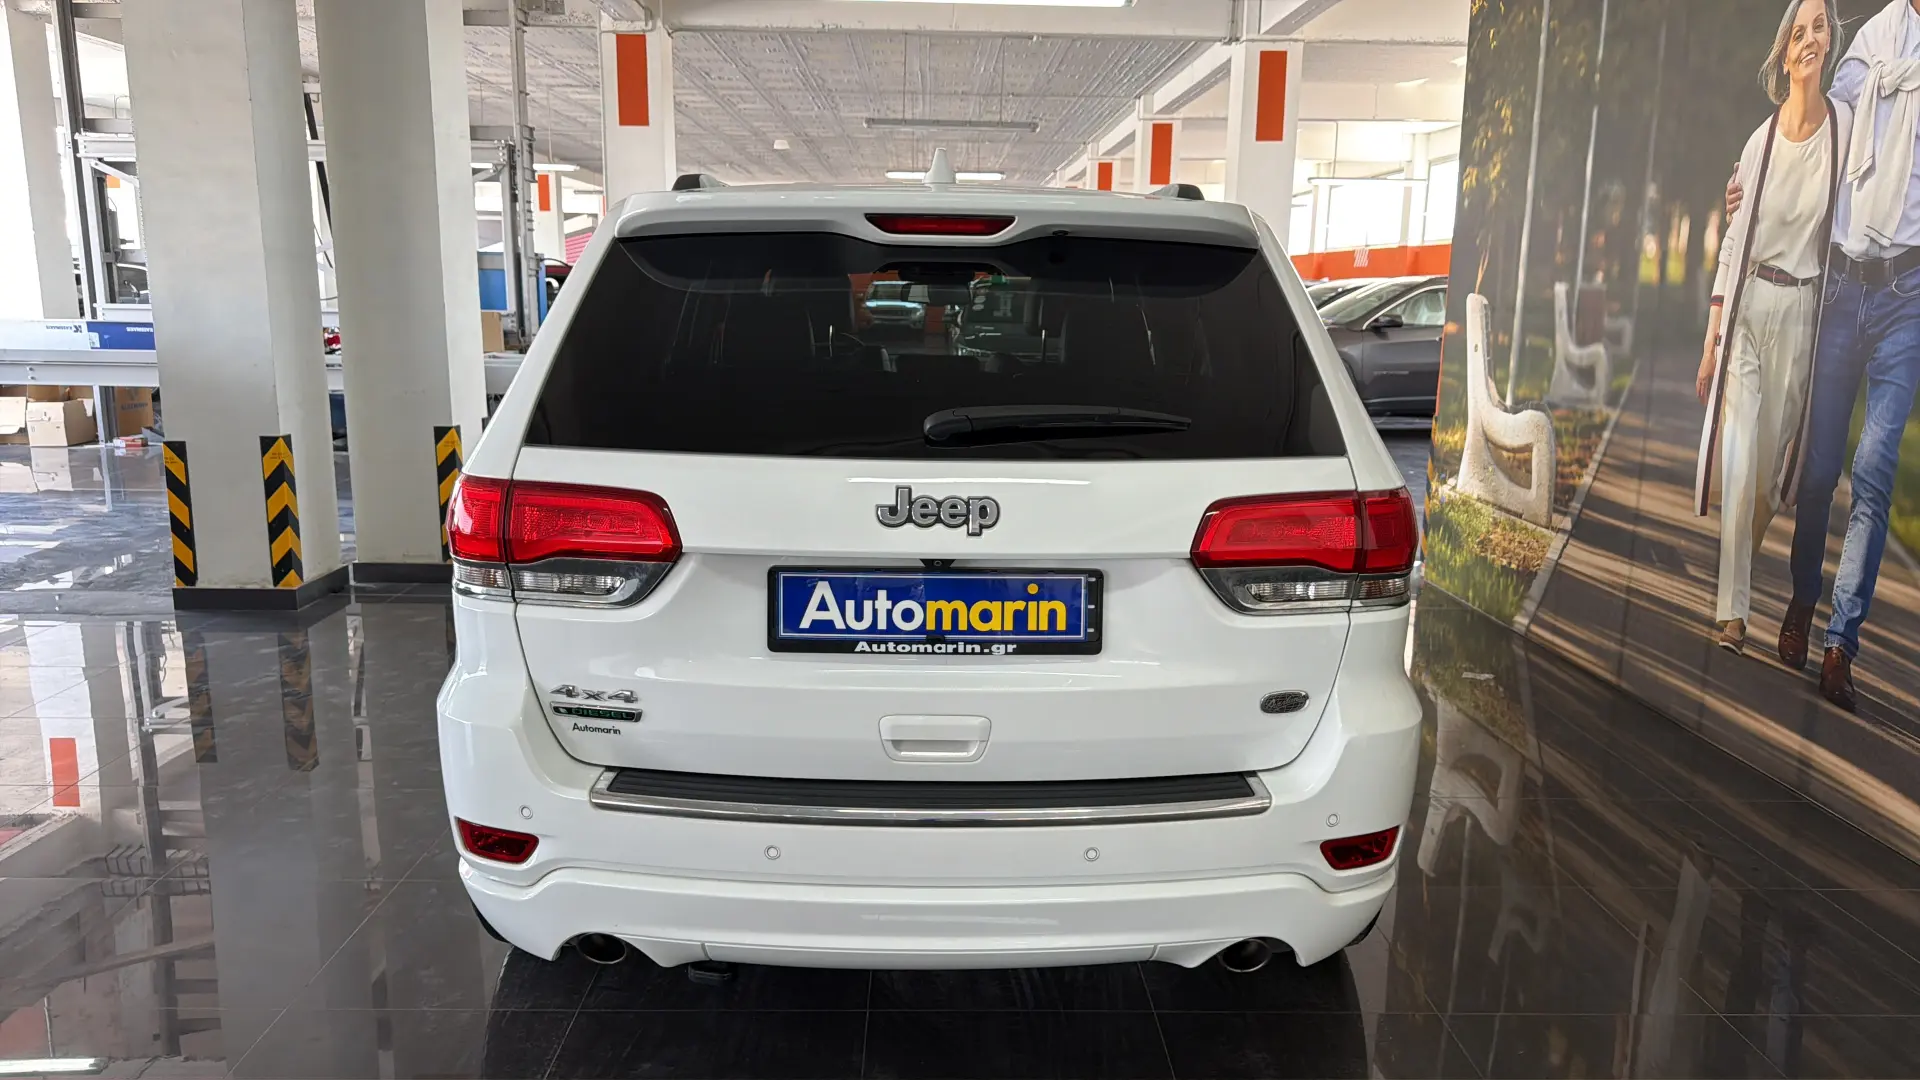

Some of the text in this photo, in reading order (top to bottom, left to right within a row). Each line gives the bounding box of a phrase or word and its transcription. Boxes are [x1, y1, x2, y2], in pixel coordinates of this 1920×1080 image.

[876, 485, 1000, 536] Jeep
[799, 580, 1066, 632] Automarin
[853, 640, 1017, 655] Automarin.gr
[549, 684, 639, 704] 4x4
[571, 707, 633, 719] DIESEL
[572, 722, 621, 735] Automarin
